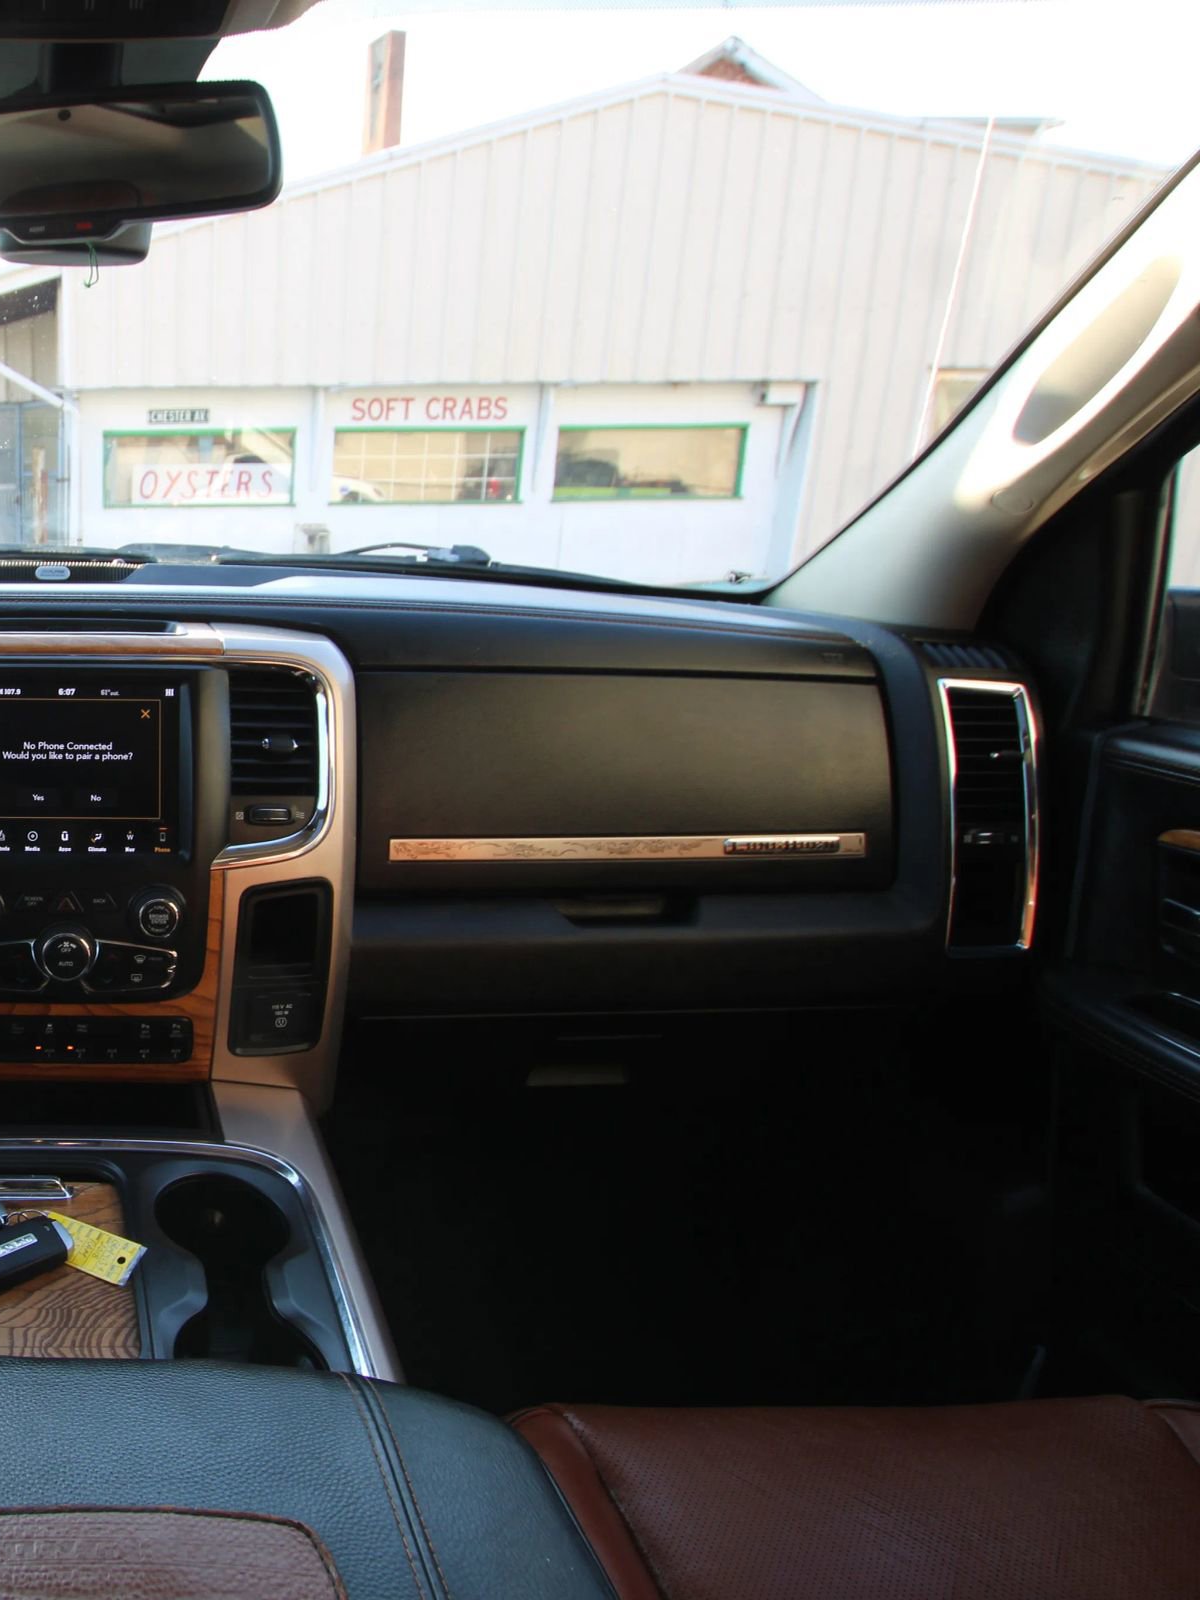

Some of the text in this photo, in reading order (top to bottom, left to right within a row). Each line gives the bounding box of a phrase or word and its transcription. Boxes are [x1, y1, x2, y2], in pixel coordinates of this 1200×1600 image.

[351, 395, 509, 422] SOFT CRABS
[139, 469, 275, 500] OYSTERS
[57, 688, 76, 697] 6:07
[165, 688, 175, 697] HI
[23, 741, 113, 751] No Phone Connected
[2, 751, 30, 760] Would
[31, 753, 47, 762] you
[48, 751, 63, 760] like
[65, 752, 74, 760] to
[76, 752, 92, 762] pair
[102, 752, 133, 762] phone?
[32, 794, 45, 802] Yes
[90, 794, 102, 802] No
